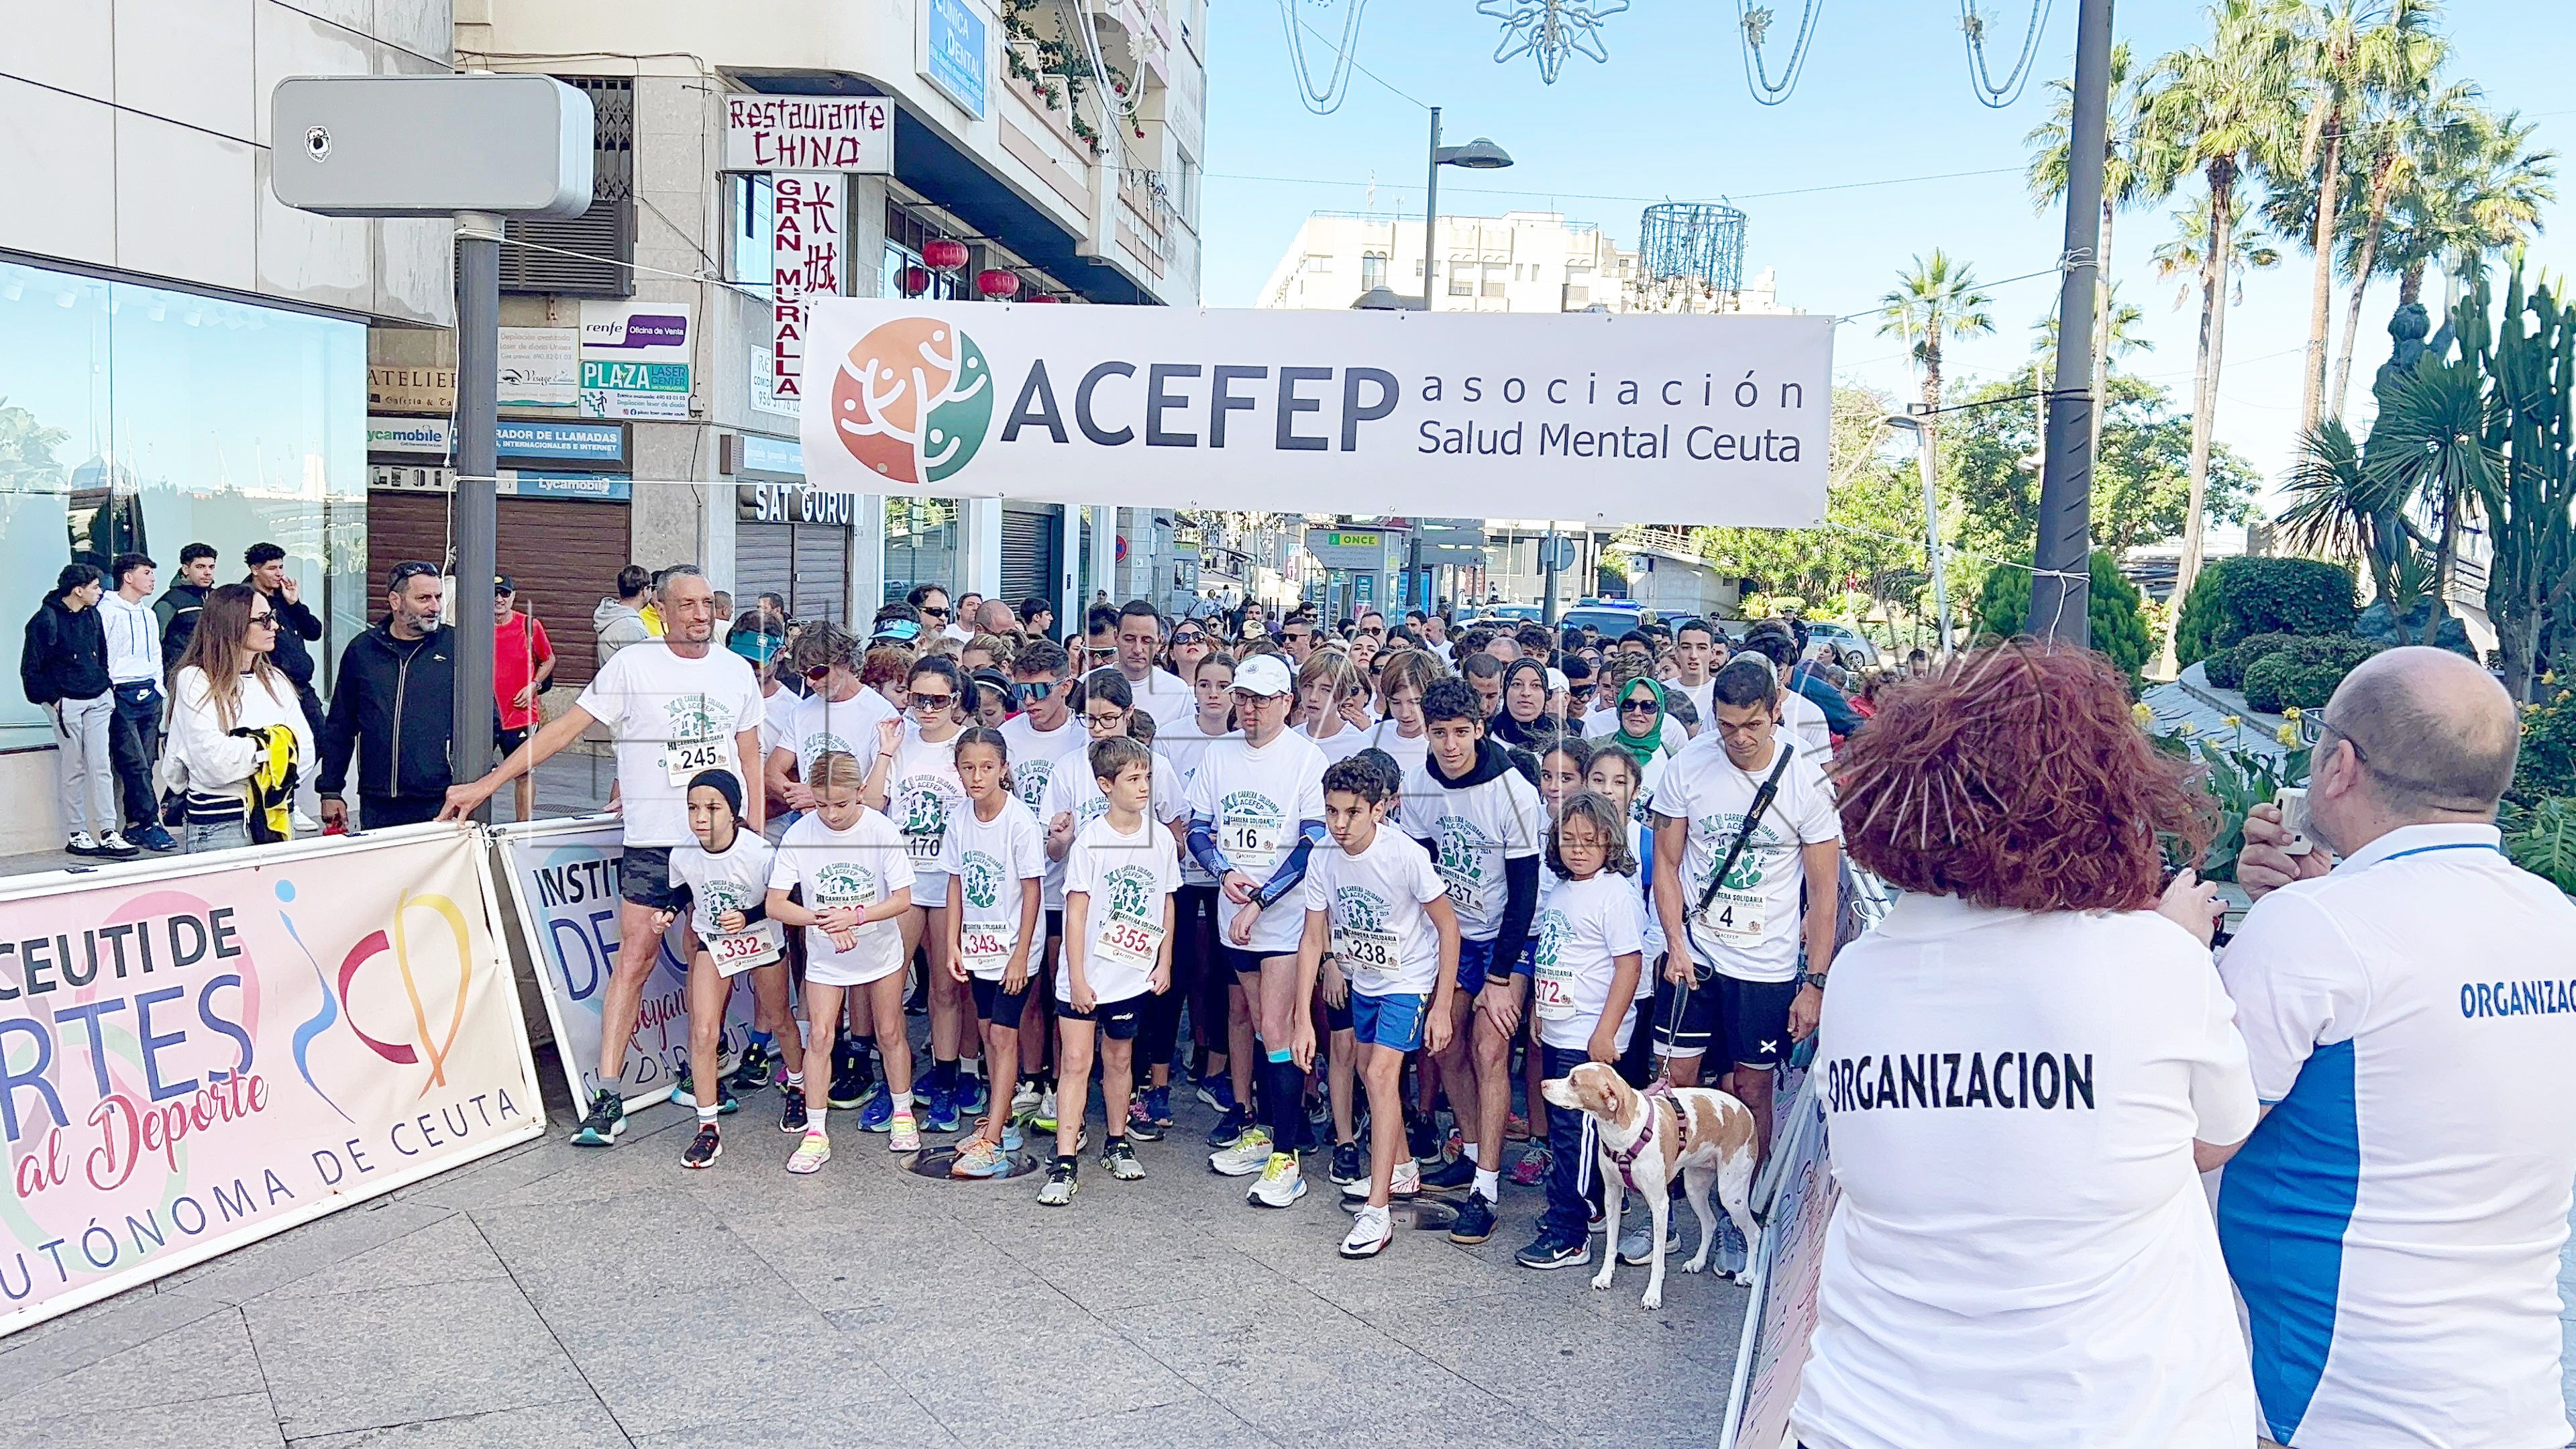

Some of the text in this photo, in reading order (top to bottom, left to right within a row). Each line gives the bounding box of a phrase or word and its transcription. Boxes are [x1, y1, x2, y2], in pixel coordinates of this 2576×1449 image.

[946, 27, 981, 82] DENTAL
[729, 99, 885, 131] Restaurante
[753, 133, 861, 167] CHINO
[775, 179, 801, 251] GRAN
[586, 321, 623, 336] renfe
[629, 326, 653, 334] Oficina
[664, 327, 684, 335] Venta
[775, 269, 801, 395] MURALLA
[584, 363, 650, 389] PLAZA
[651, 366, 686, 376] LASER
[651, 377, 686, 386] CENTER
[1000, 359, 1803, 451] ACEFEP asociación
[503, 440, 571, 451] INTERNACIONALES
[580, 443, 617, 452] INTERNET
[537, 429, 552, 441] DE
[555, 431, 617, 443] LLAMADAS
[1418, 420, 1801, 462] Salud Mental Ceuta
[538, 477, 609, 491] Lycamobil
[755, 484, 850, 525] SAT GURU
[1344, 536, 1375, 545] ONCE
[681, 746, 716, 769] 245
[1033, 767, 1051, 776] ACEFE
[1221, 792, 1239, 813] XI
[1238, 790, 1258, 799] CARRERA
[1240, 798, 1264, 810] ACEFEP
[1236, 828, 1257, 849] 16
[1446, 822, 1471, 836] ACEFEP
[1699, 812, 1779, 843] XI CARRE OLIDARIA
[910, 837, 940, 857] 170
[1104, 869, 1122, 887] XI
[1442, 867, 1460, 880] CARRERA
[851, 891, 875, 901] SOLIDARIA
[1444, 879, 1472, 904] 237
[1733, 894, 1763, 904] SOLIDARIA
[1119, 912, 1140, 926] CARRERA
[1141, 920, 1165, 934] SOLIDARIA
[1720, 906, 1733, 927] 4
[168, 907, 241, 967] DE
[722, 936, 761, 958] 332
[969, 934, 999, 954] 343
[1112, 924, 1150, 953] 355
[1371, 934, 1397, 942] SOLIDARIA
[1352, 940, 1386, 965] 238
[1547, 969, 1572, 977] SOLIDARIA
[1536, 978, 1560, 1002] 372
[1828, 1051, 2096, 1113] ORGANIZACION
[16, 1067, 269, 1199] al Deporte
[311, 1138, 376, 1185] DE
[390, 1087, 521, 1157] CEUTA
